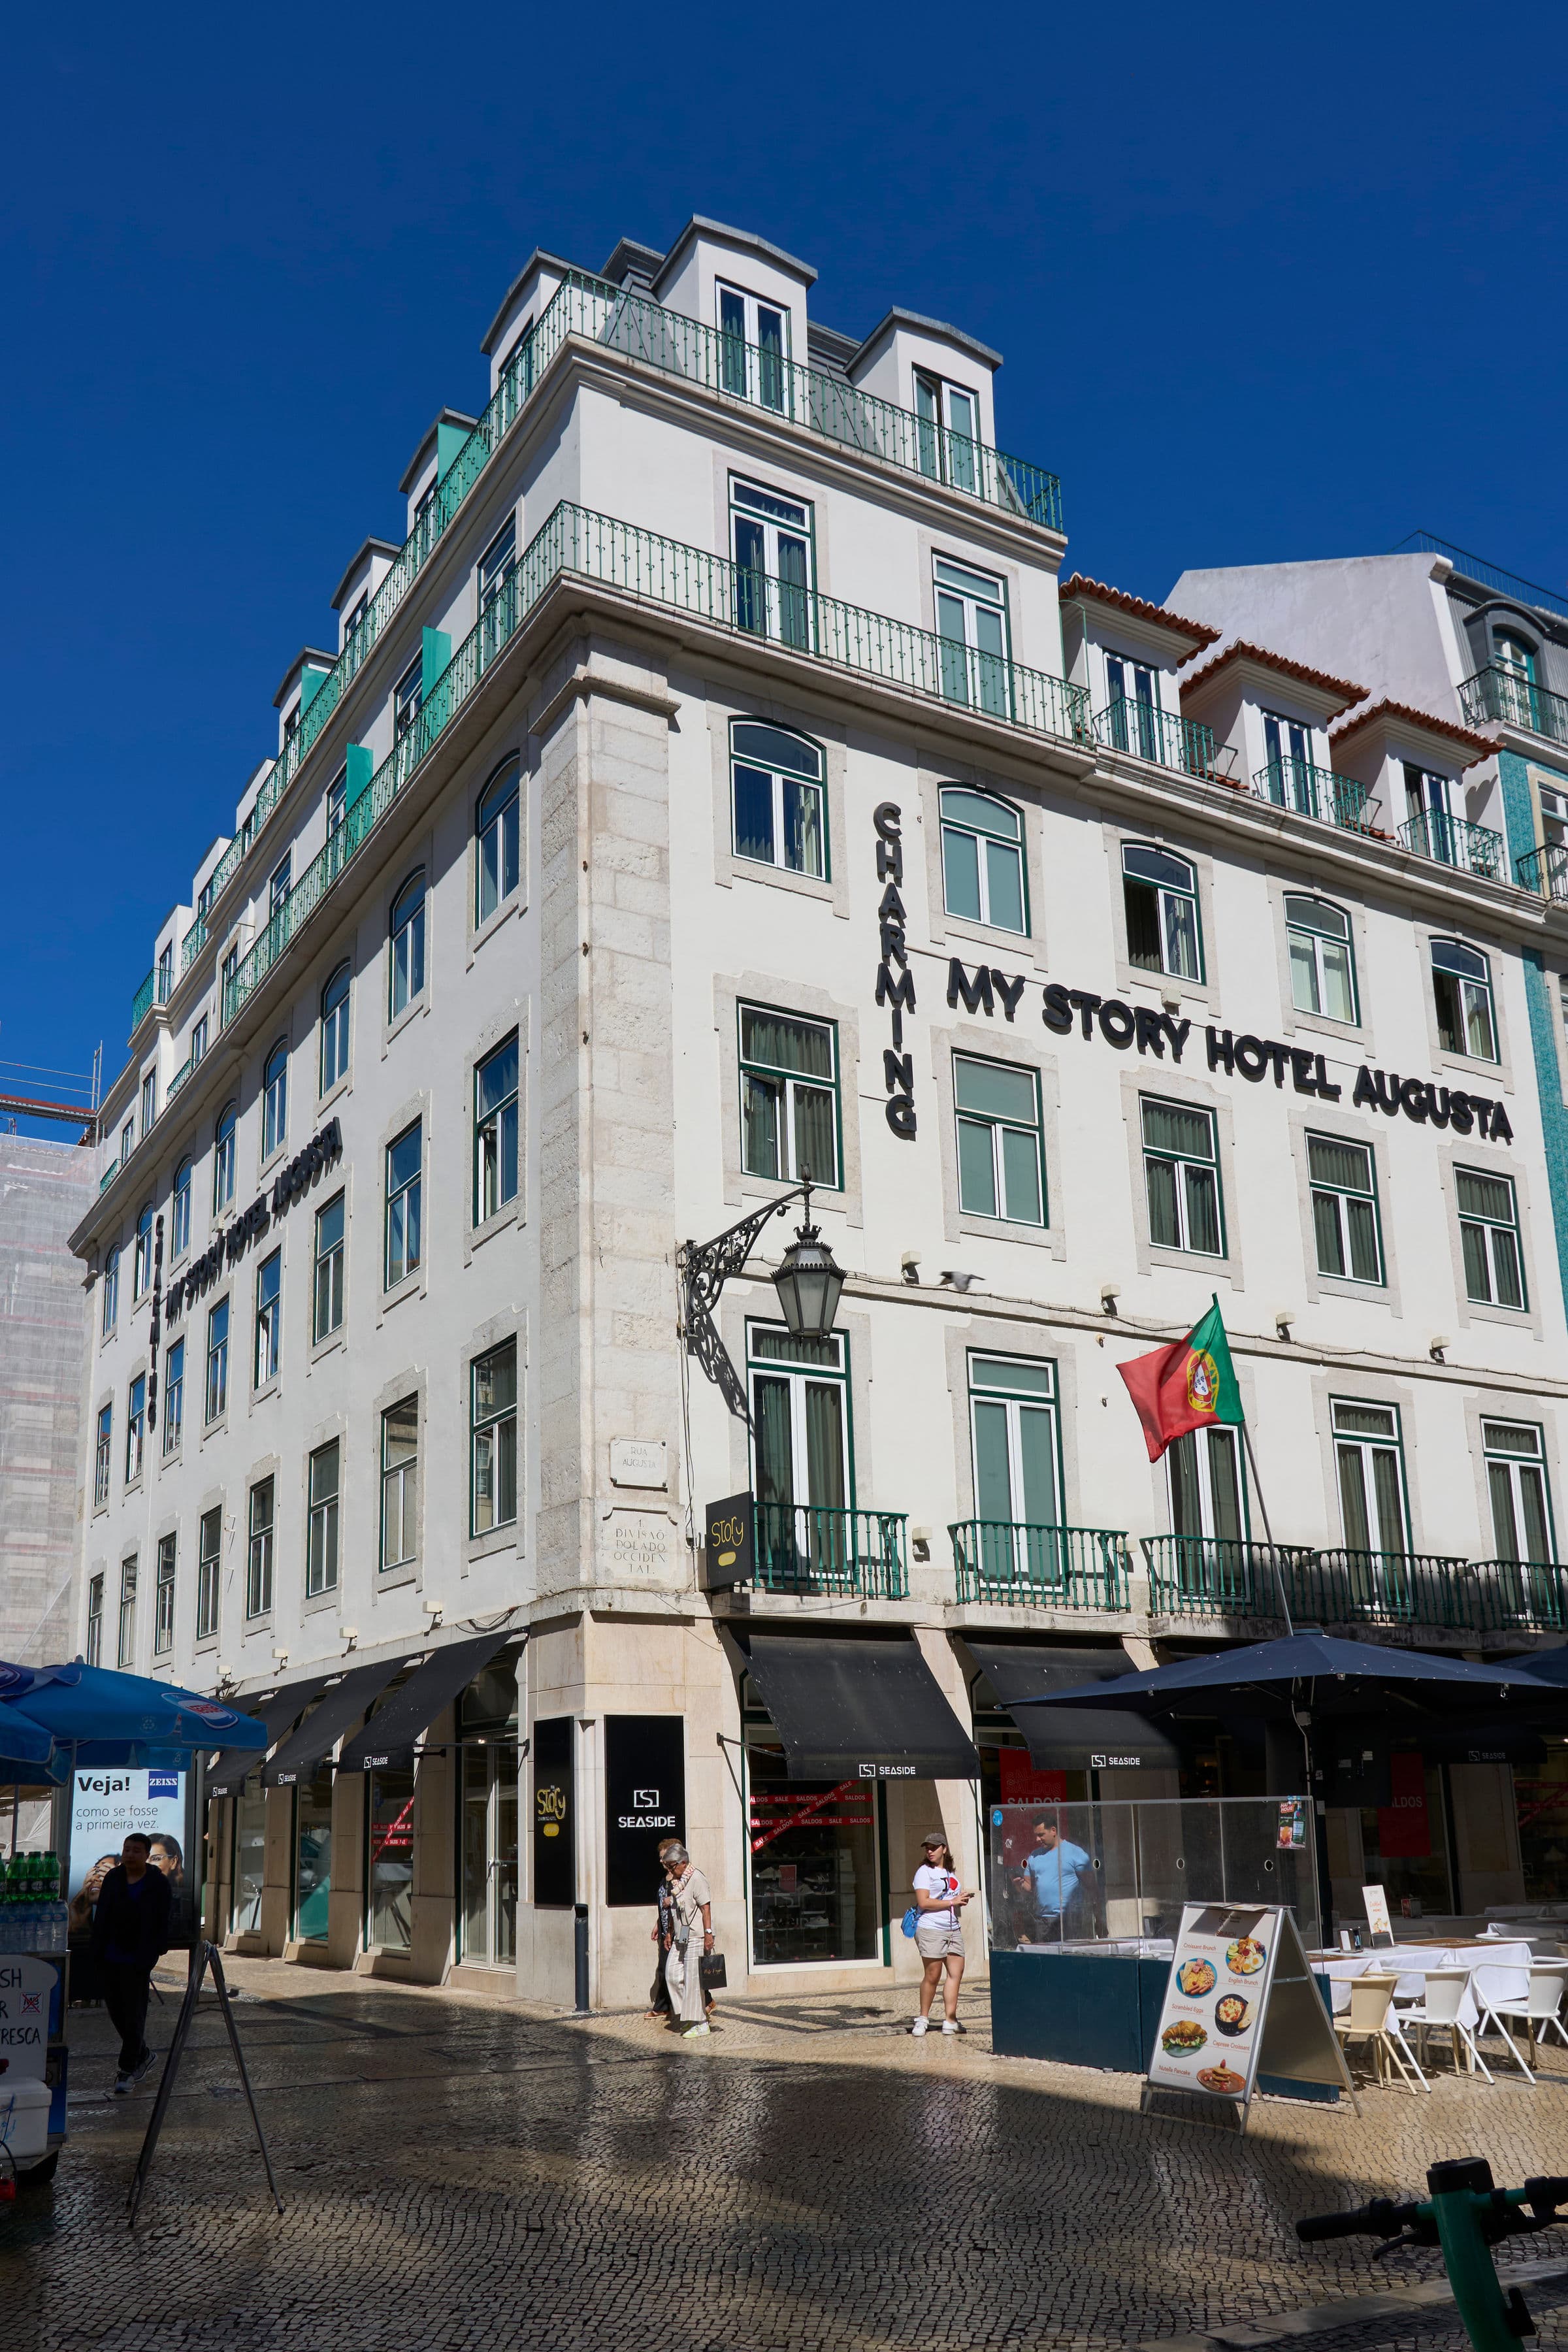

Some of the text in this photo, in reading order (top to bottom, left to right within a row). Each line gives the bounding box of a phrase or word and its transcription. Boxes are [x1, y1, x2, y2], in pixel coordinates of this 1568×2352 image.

[873, 801, 916, 1134] CHARMING
[947, 958, 1513, 1139] MY STORY HOTEL AUGUSTA
[630, 1446, 648, 1456] RUA
[623, 1458, 657, 1469] AUGUSTA
[372, 1757, 388, 1765] SEASIDE
[1109, 1757, 1141, 1765] SEASIDE
[879, 1766, 916, 1775] SEASIDE
[78, 1776, 130, 1795] Veja!
[76, 1808, 109, 1817] como
[129, 1805, 158, 1816] fosse
[755, 1835, 768, 1847] SALE
[773, 1819, 793, 1835] SALDOS
[798, 1807, 811, 1819] SALE
[815, 1791, 835, 1807] SALDOS
[840, 1780, 853, 1791] SALE
[76, 1819, 159, 1833] a primeira vez.
[618, 1816, 676, 1828] SEASIDE
[0, 1968, 21, 1987] SH
[1171, 2003, 1192, 2012] Scrambled
[0, 2027, 41, 2045] RESCA
[1230, 2042, 1250, 2051] Croissant
